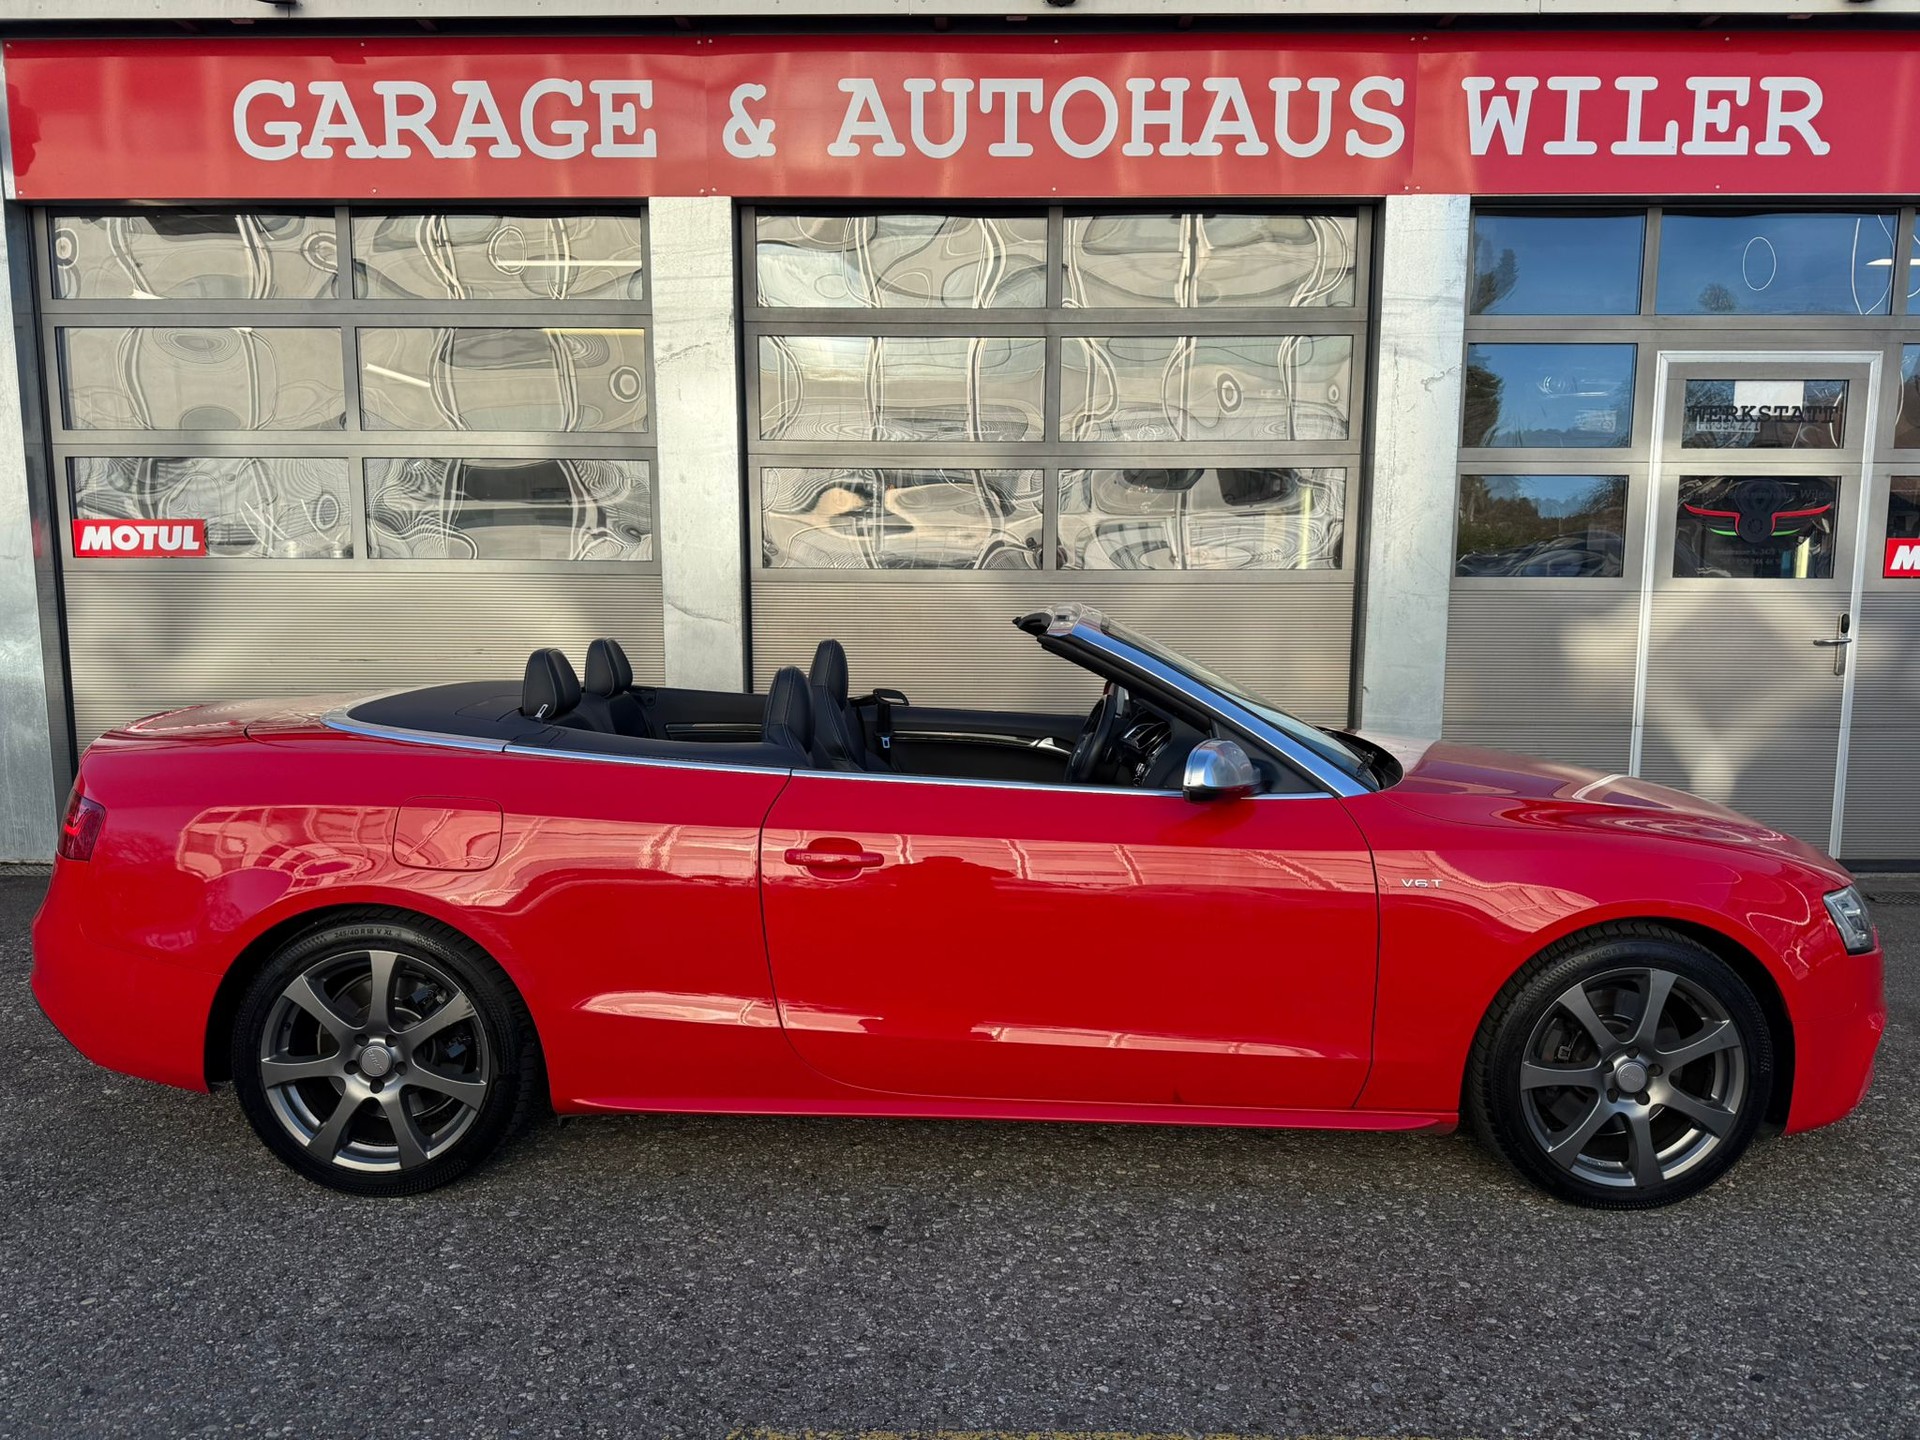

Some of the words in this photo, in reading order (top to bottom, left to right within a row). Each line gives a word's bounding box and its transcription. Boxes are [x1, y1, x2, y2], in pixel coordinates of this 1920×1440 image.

[233, 78, 659, 160] GARAGE
[722, 83, 777, 159] &
[826, 76, 1406, 159] AUTOHAUS
[1461, 76, 1832, 157] WILER
[1687, 405, 1839, 423] WERKSTATT
[80, 525, 200, 551] MOTUL
